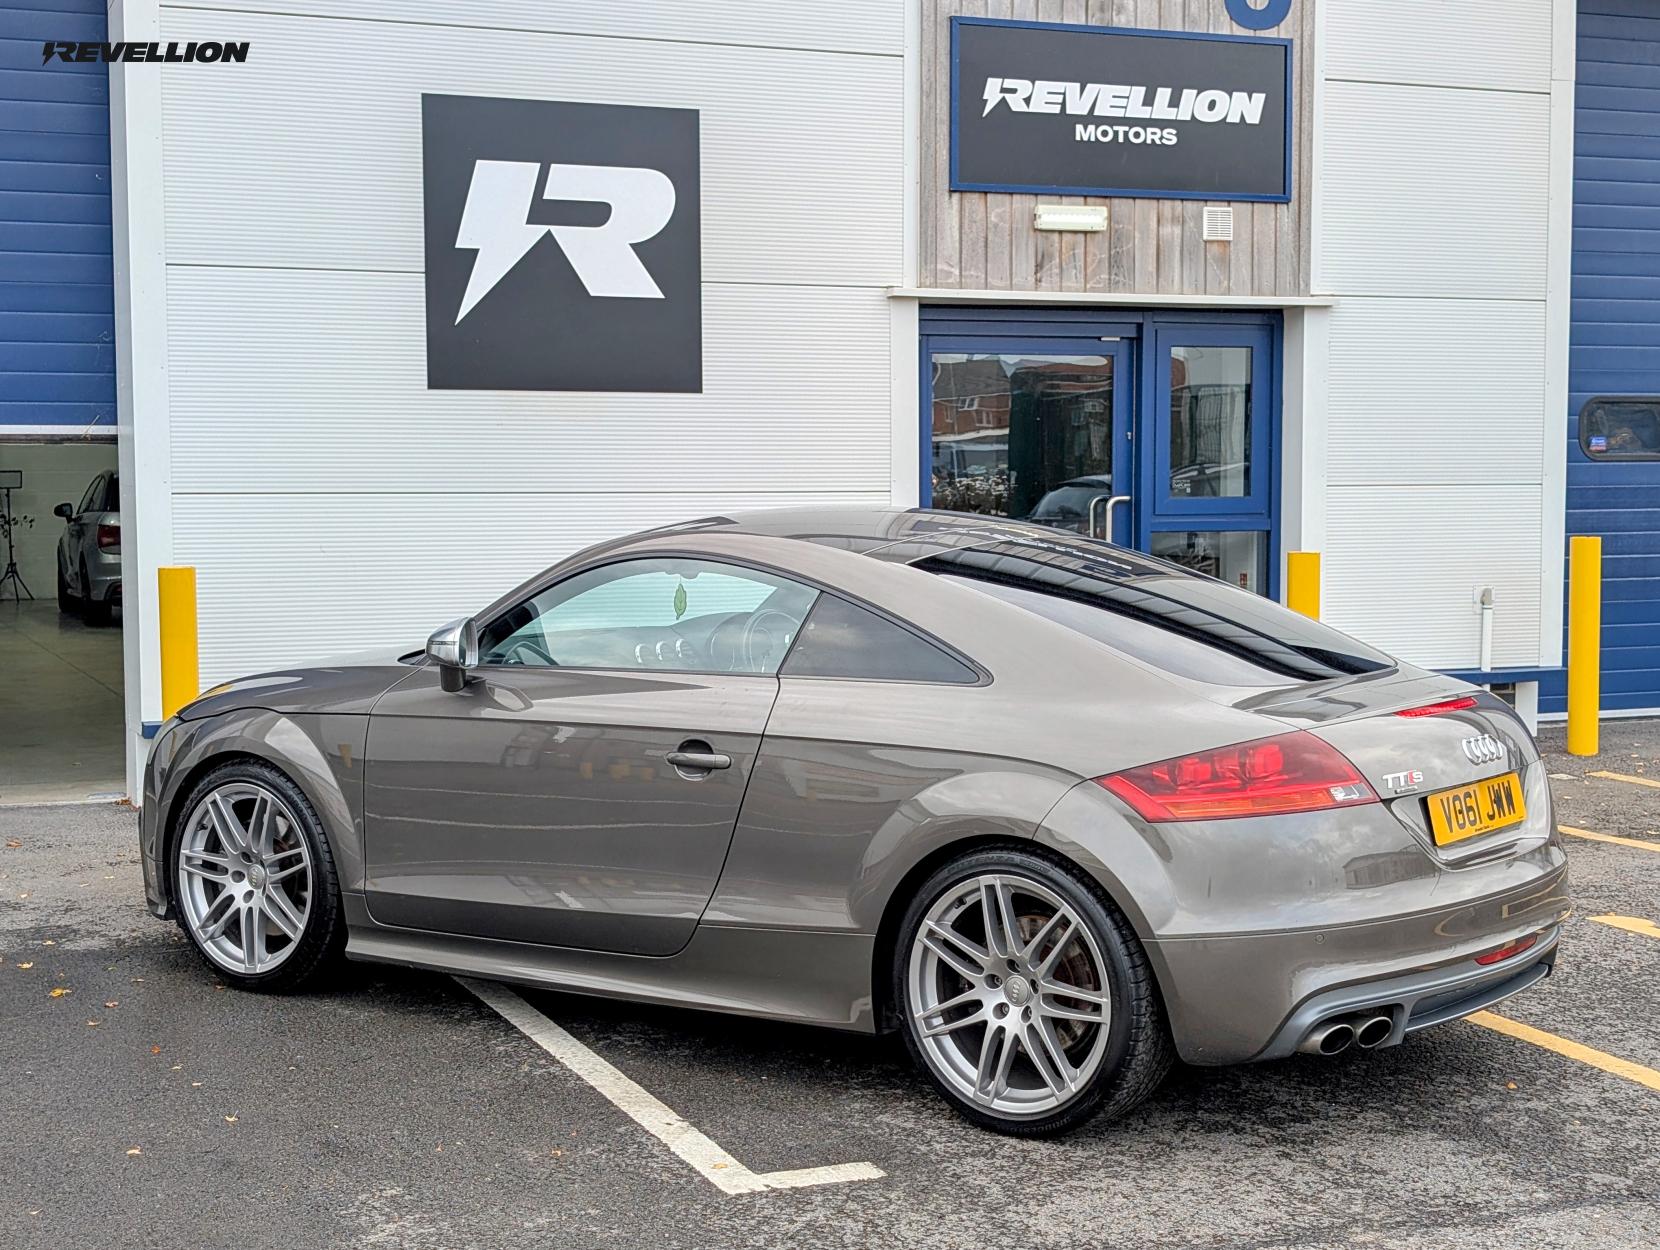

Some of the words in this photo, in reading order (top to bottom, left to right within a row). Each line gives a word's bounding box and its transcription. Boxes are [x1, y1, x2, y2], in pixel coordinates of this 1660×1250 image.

[982, 77, 1266, 124] REVELLION
[1075, 124, 1178, 145] MOTORS
[1382, 770, 1424, 789] TTS
[1486, 780, 1516, 821] JWW
